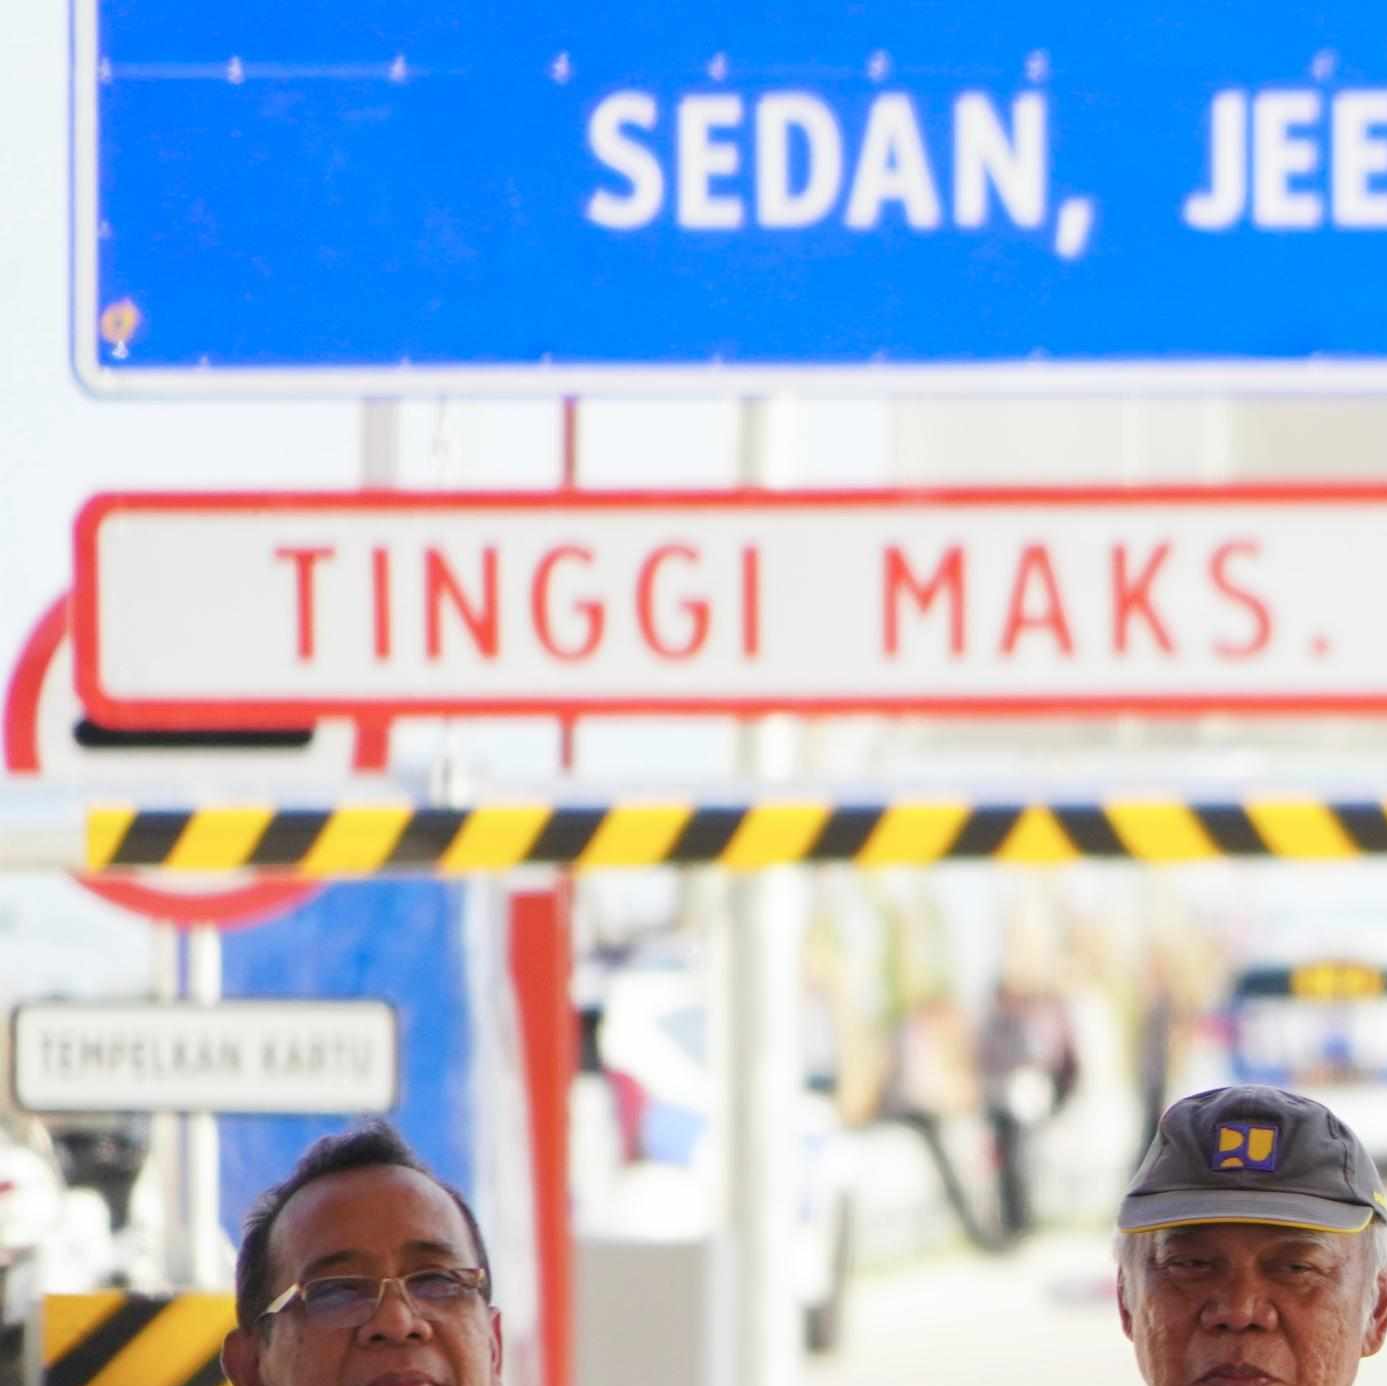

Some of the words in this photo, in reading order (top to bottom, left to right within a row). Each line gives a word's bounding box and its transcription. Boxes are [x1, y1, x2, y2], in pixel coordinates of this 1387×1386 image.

[588, 91, 1093, 258] SEDAN,
[273, 543, 761, 665] TINGGI
[881, 541, 1329, 660] MAKS.
[38, 1029, 243, 1081] TEMPELKAN
[260, 1030, 375, 1081] KARTU
